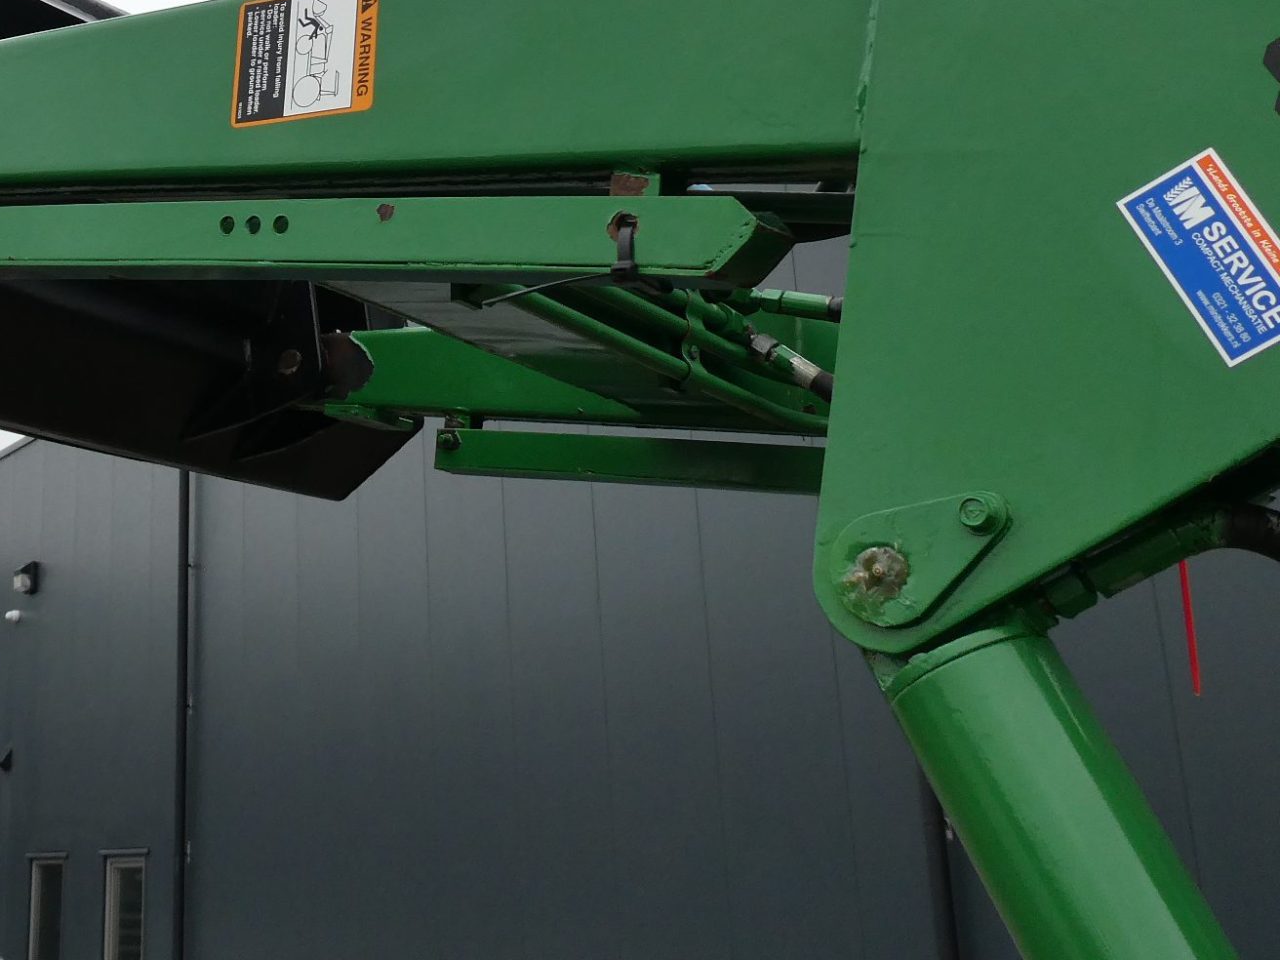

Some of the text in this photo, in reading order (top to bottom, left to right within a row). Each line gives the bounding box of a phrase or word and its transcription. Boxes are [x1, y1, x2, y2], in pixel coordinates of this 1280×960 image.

[266, 8, 273, 19] Do
[280, 1, 286, 11] To
[250, 58, 256, 66] to
[263, 52, 269, 60] or
[356, 17, 372, 96] WARNING
[272, 74, 281, 98] falling
[1145, 197, 1155, 208] De
[1226, 194, 1253, 227] Grootste
[1250, 229, 1261, 238] in
[1259, 239, 1279, 263] Kleine
[1192, 232, 1267, 333] COMPACT MECHANISATIE
[1204, 222, 1280, 327] SERVICE
[1212, 292, 1227, 309] 0321
[1226, 313, 1238, 324] 32
[1233, 322, 1244, 333] 38
